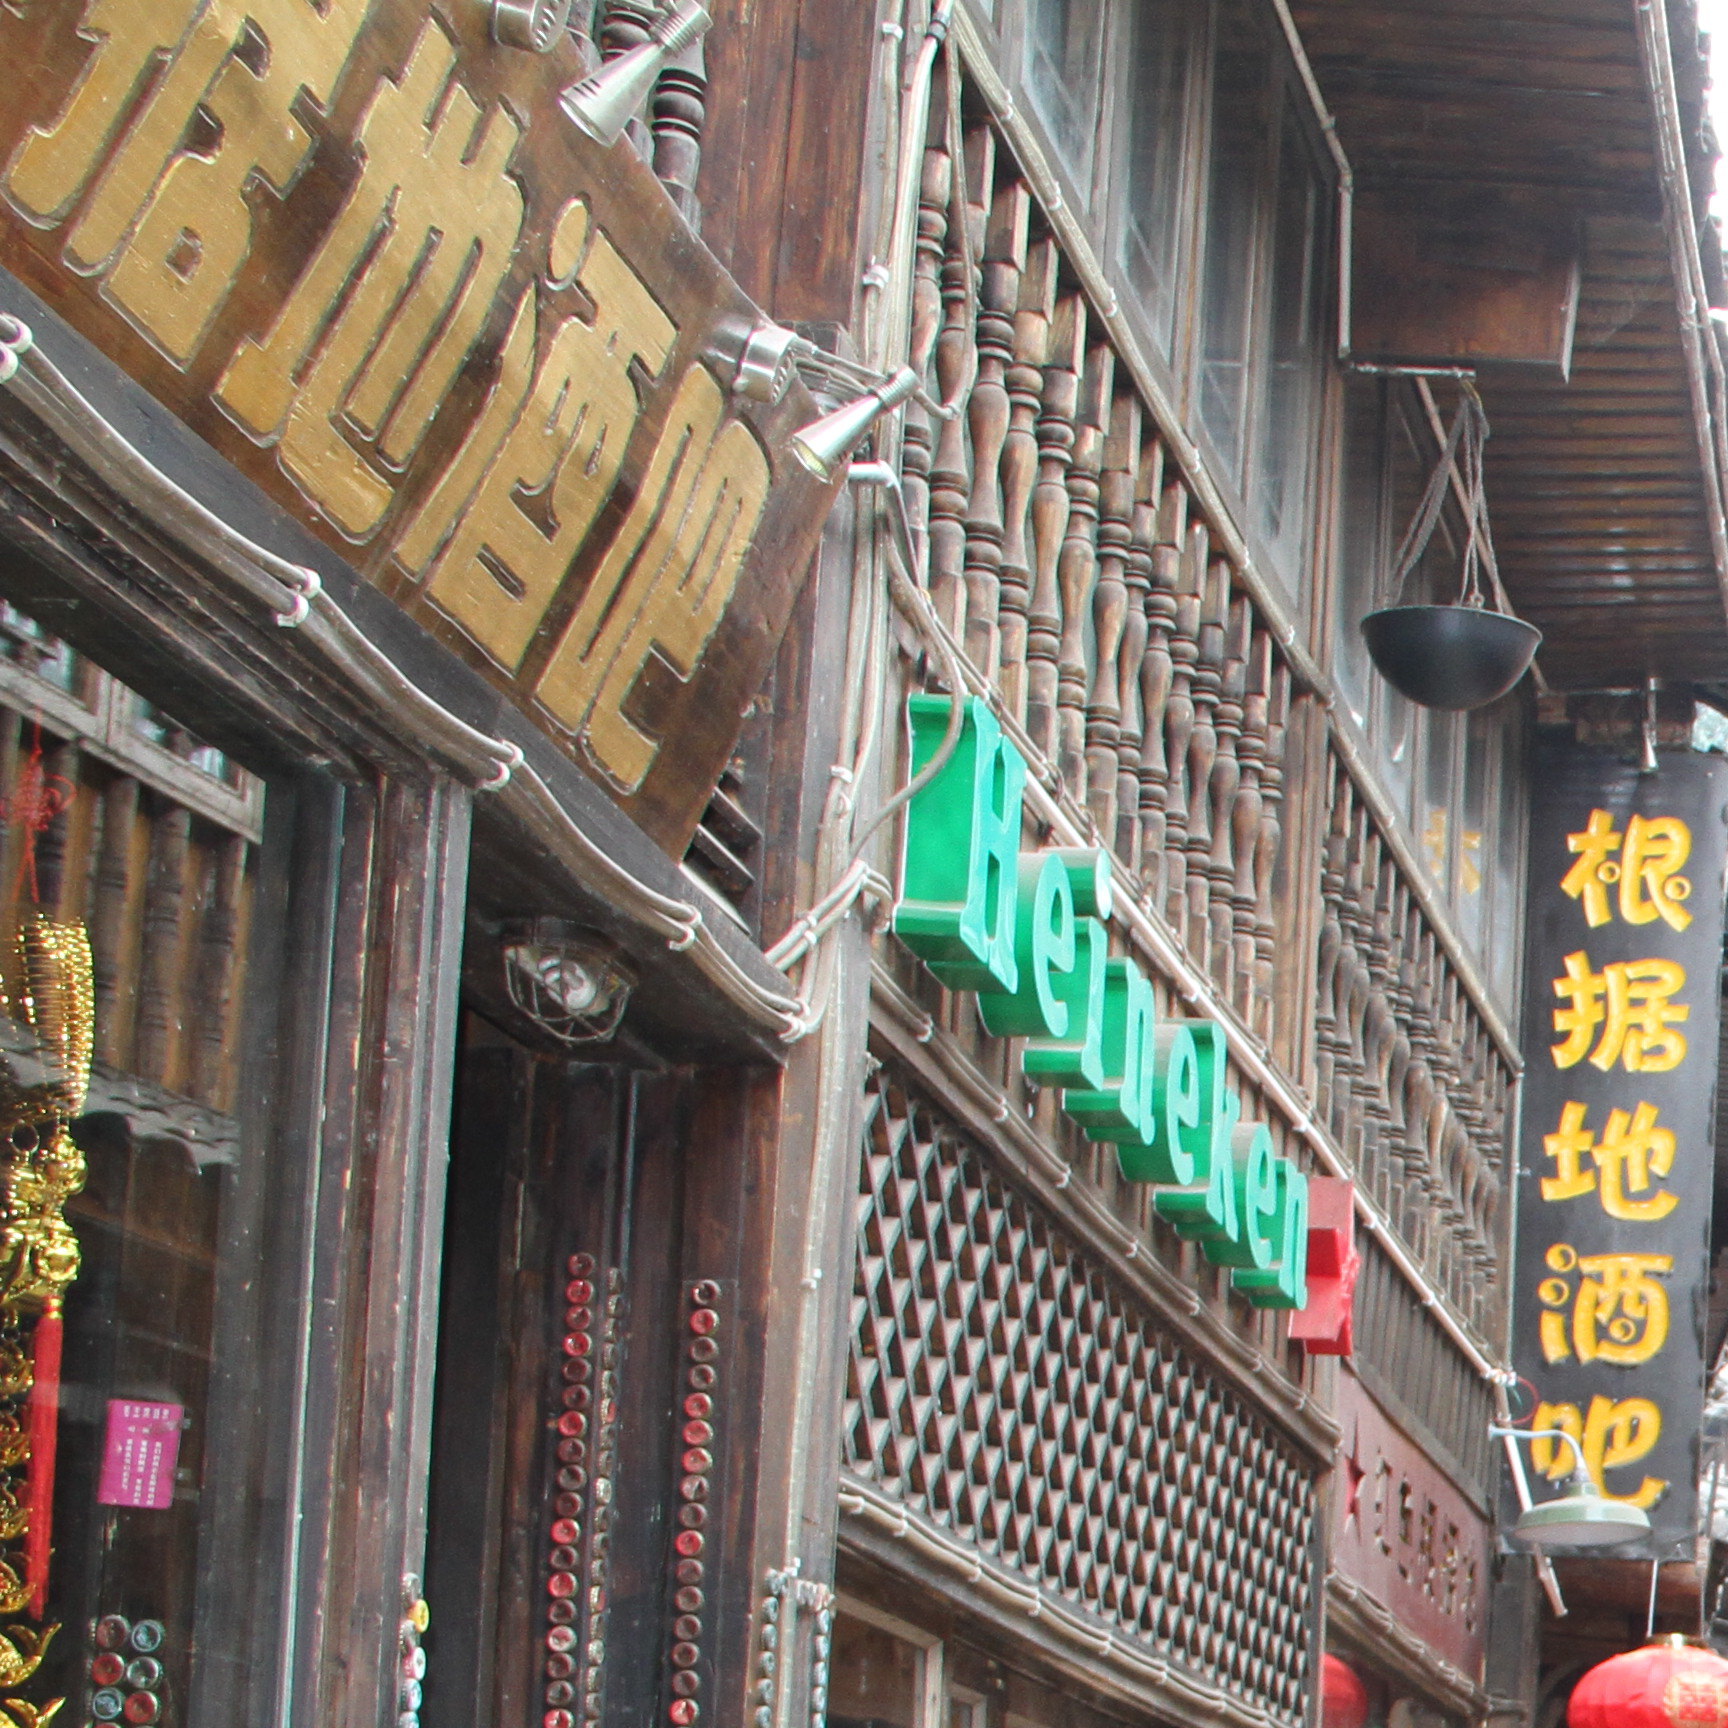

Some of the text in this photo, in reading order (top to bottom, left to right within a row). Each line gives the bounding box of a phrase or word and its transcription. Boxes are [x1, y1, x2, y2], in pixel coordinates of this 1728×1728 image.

[957, 694, 1309, 1311] Heineken
[1531, 808, 1693, 1510] 根据地酒吧
